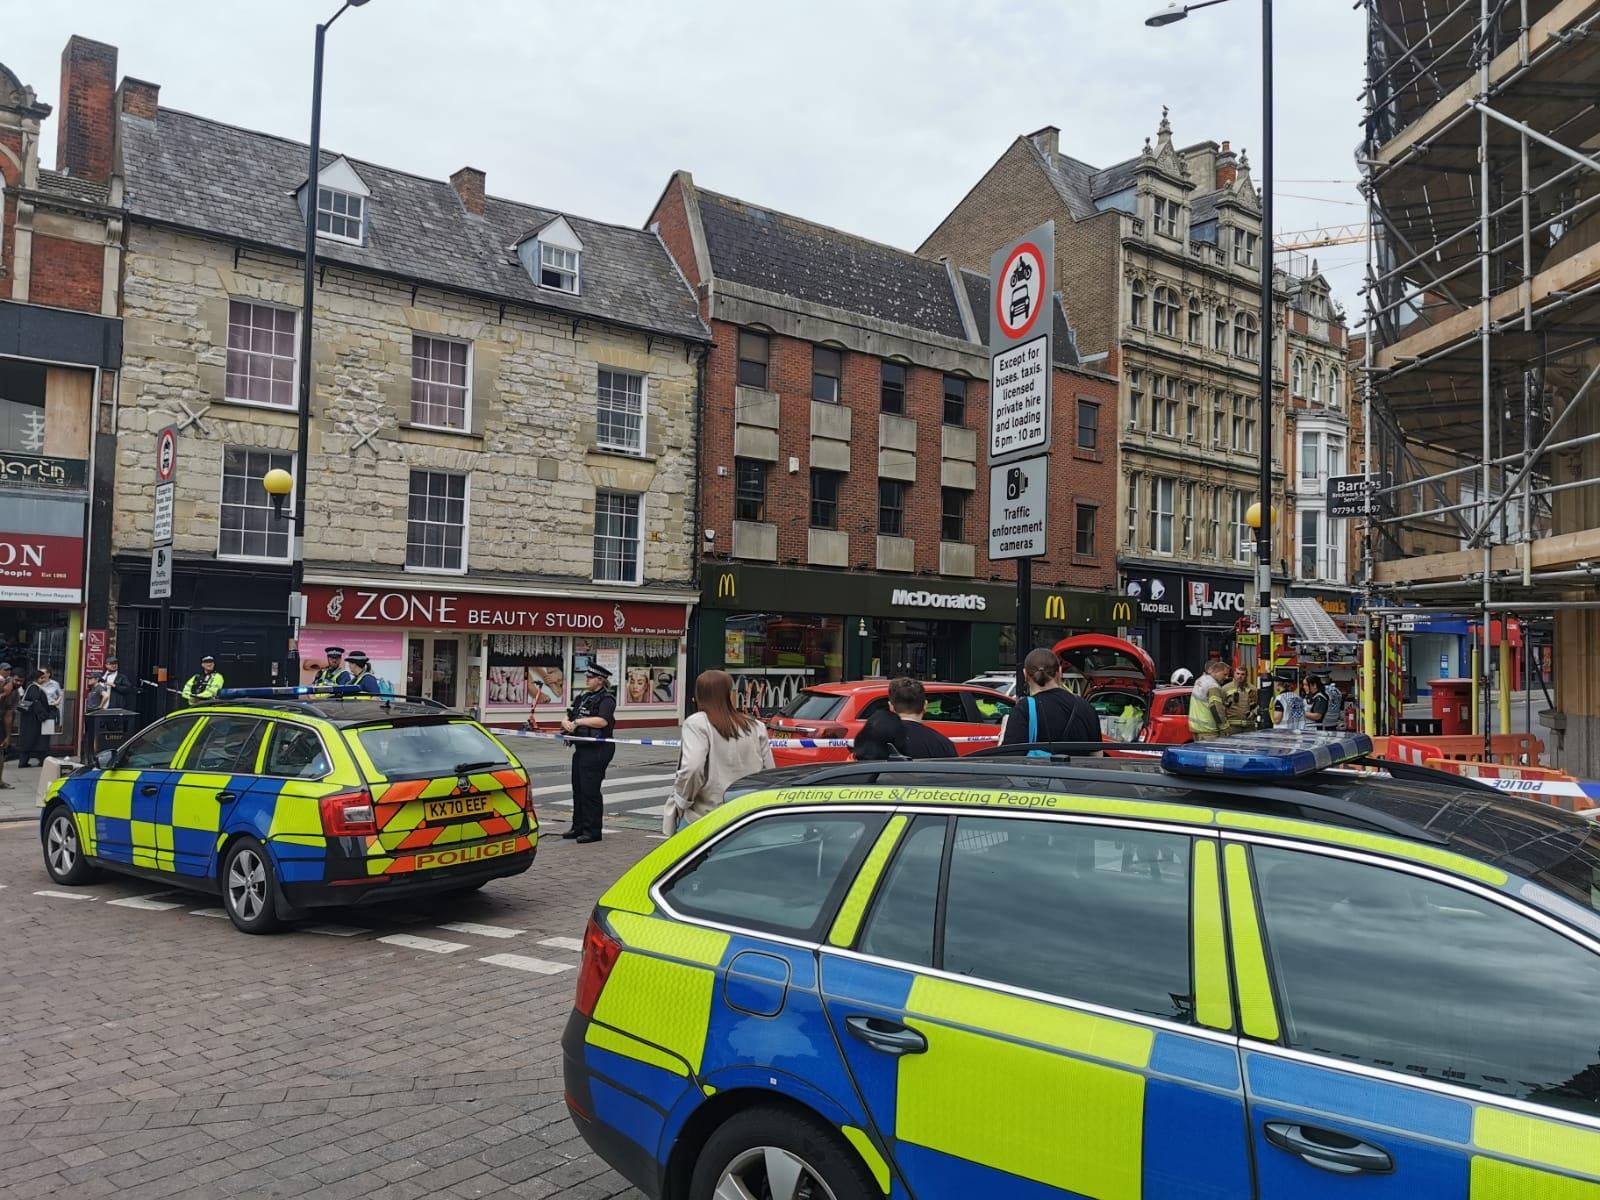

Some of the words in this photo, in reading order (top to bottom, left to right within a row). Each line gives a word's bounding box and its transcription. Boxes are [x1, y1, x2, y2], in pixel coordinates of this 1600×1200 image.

[1000, 351, 1025, 371] Except
[1028, 348, 1040, 360] for
[1003, 379, 1034, 400] licensed
[997, 400, 1023, 419] private
[1025, 394, 1041, 409] hire
[996, 418, 1010, 433] and
[1012, 411, 1040, 428] loading
[995, 436, 1000, 448] 6
[1001, 436, 1013, 448] pm
[1018, 428, 1028, 441] 10
[1029, 428, 1041, 438] am
[1004, 506, 1030, 520] Traffic
[992, 520, 1042, 537] enforcement
[1000, 539, 1033, 551] cameras
[892, 589, 986, 610] McDonald's
[1140, 602, 1159, 613] TACO
[1159, 604, 1175, 614] BELL
[1212, 591, 1245, 611] KFC
[354, 591, 457, 623] ZONE
[468, 609, 539, 626] BEAUTY
[545, 612, 604, 629] STUDIO
[1492, 779, 1543, 791] POLICE
[429, 801, 462, 818] KX70
[466, 797, 488, 813] EEF
[775, 789, 834, 803] Fighting
[838, 788, 884, 800] Crime
[888, 788, 900, 800] &
[906, 788, 991, 806] Protecting
[998, 792, 1058, 808] People
[417, 841, 515, 869] POLICE
